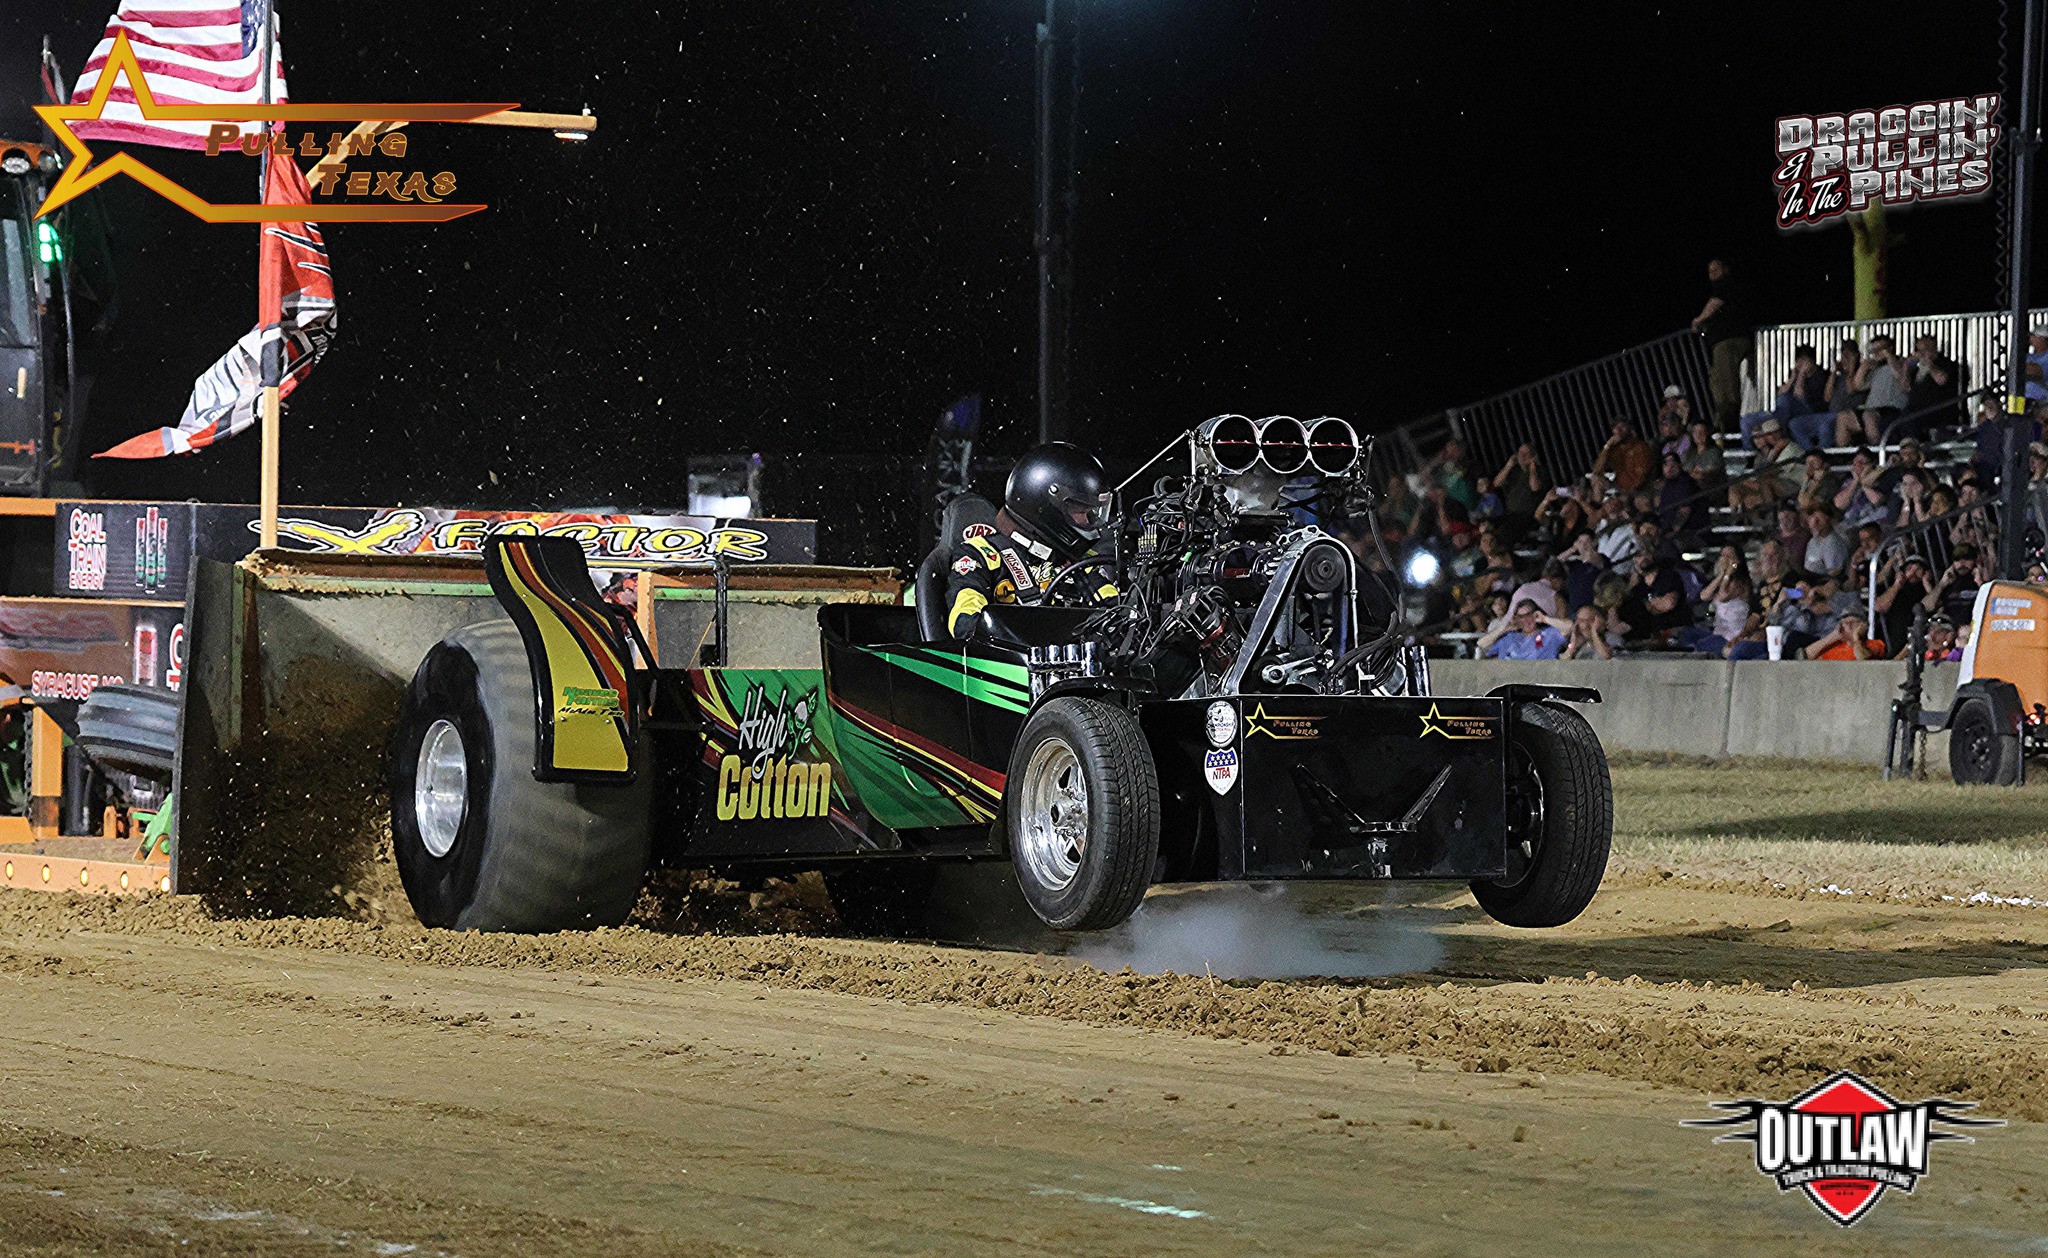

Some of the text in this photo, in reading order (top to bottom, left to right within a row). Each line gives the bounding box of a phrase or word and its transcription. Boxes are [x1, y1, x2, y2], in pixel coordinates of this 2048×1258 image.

[70, 508, 106, 543] COAL
[68, 539, 107, 575] TRAIN
[1002, 552, 1029, 587] SIMPSON
[69, 571, 105, 590] ENERGY
[738, 686, 788, 780] High
[716, 753, 832, 821] Cotton
[1212, 766, 1231, 780] NTPA
